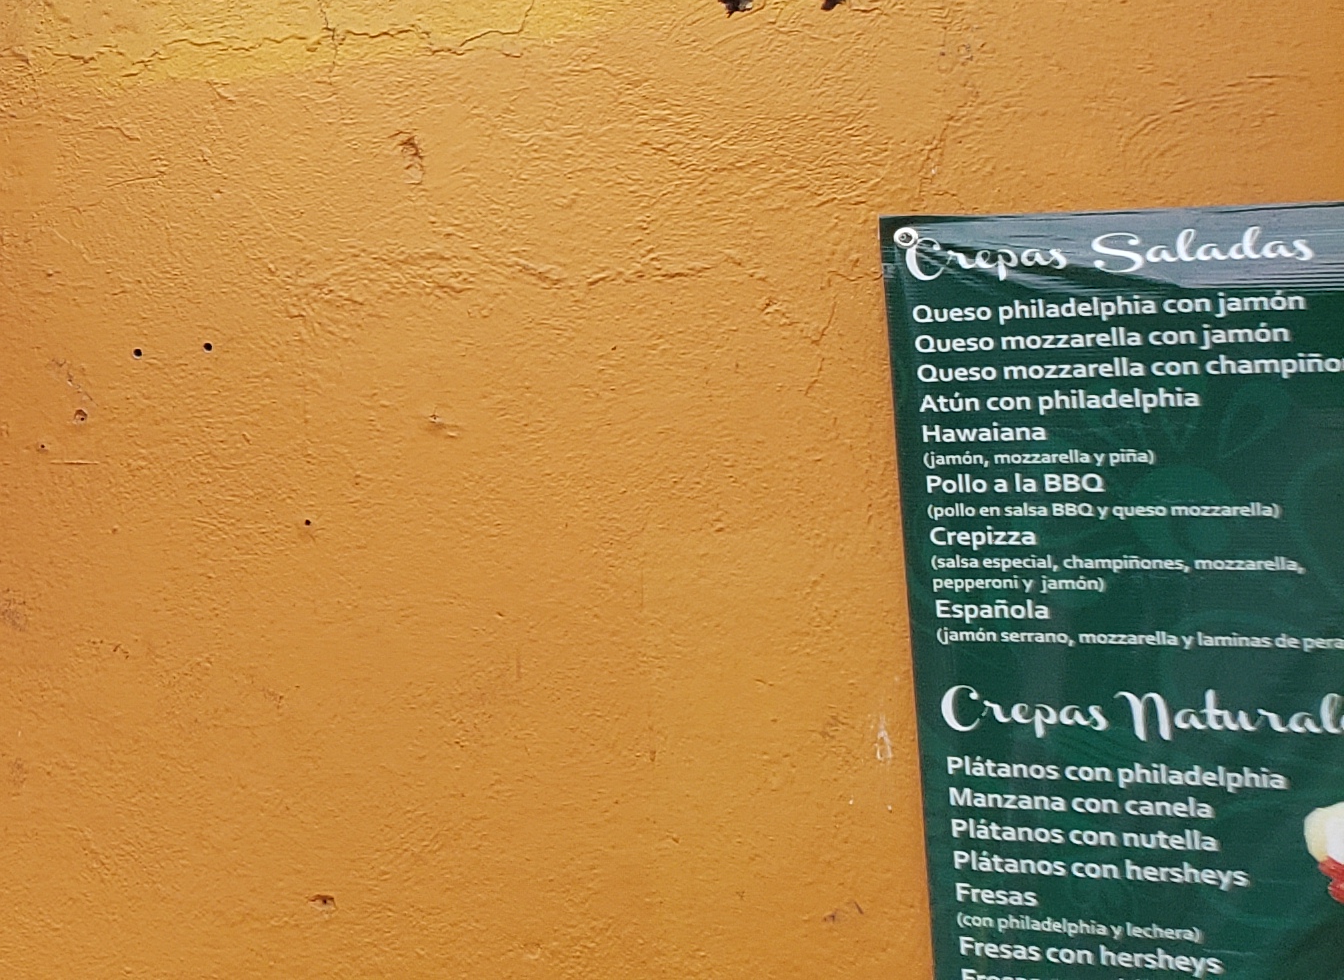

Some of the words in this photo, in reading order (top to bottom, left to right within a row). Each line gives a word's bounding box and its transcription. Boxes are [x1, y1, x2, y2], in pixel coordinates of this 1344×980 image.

[905, 237, 1068, 280] Crepas
[1091, 226, 1314, 273] Saladas
[912, 304, 992, 324] Queso
[998, 294, 1157, 325] philadelphia
[1163, 297, 1212, 314] con
[1215, 290, 1307, 318] jamón
[915, 334, 994, 354] Queso
[1001, 327, 1142, 351] mozzarella
[1148, 328, 1198, 345] con
[1199, 322, 1291, 351] jamón
[917, 363, 997, 383] Queso
[1003, 356, 1145, 380] mozzarella
[1150, 358, 1200, 376] con
[1205, 353, 1344, 379] champiño
[920, 391, 980, 413] Atún
[986, 394, 1032, 411] con
[1038, 388, 1202, 415] philadelphia
[922, 424, 1048, 443] Hawaiana
[994, 448, 1092, 465] mozzarella
[1093, 451, 1106, 467] y
[926, 474, 988, 495] Pollo
[993, 479, 1009, 494] a
[1014, 473, 1037, 494] la
[1044, 473, 1106, 495] BBQ
[927, 504, 977, 520] (pollo
[979, 506, 1002, 518] en
[1004, 502, 1050, 519] salsa
[1052, 502, 1097, 519] BBQ
[1097, 505, 1109, 520] y
[1112, 505, 1168, 521] queso
[1170, 502, 1282, 519] mozzarella)
[929, 527, 1038, 550] Crepizza
[931, 555, 981, 570] (salsa
[983, 555, 1059, 573] especial,
[932, 575, 1020, 593] pepperoni
[1022, 577, 1034, 593] y
[935, 600, 1050, 623] Española
[1000, 630, 1076, 648] serrano,
[1079, 630, 1179, 647] mozzarella
[1181, 633, 1194, 649] y
[1197, 632, 1273, 648] laminas
[1274, 633, 1302, 648] de
[940, 684, 1109, 738] Crepas
[1113, 688, 1344, 742] Natural
[946, 755, 1059, 781] Plátanos
[1065, 766, 1112, 783] con
[1117, 764, 1288, 793] philadelphia
[948, 786, 1066, 813] Manzana
[1071, 796, 1119, 815] con
[1124, 798, 1215, 820] canela
[951, 818, 1065, 845] Plátanos
[1069, 829, 1117, 848] con
[1122, 827, 1219, 853] nutella
[953, 850, 1067, 877] Plátanos
[1071, 862, 1120, 880] con
[1125, 859, 1250, 892] hersheys
[955, 882, 1038, 907] Fresas
[956, 912, 993, 929] (con
[997, 915, 1108, 937] philadelphia
[1110, 924, 1123, 940] y
[1126, 922, 1203, 944] lechera)
[959, 936, 1042, 961] Fresas
[1046, 946, 1094, 965] con
[1099, 944, 1224, 977] hersheys
